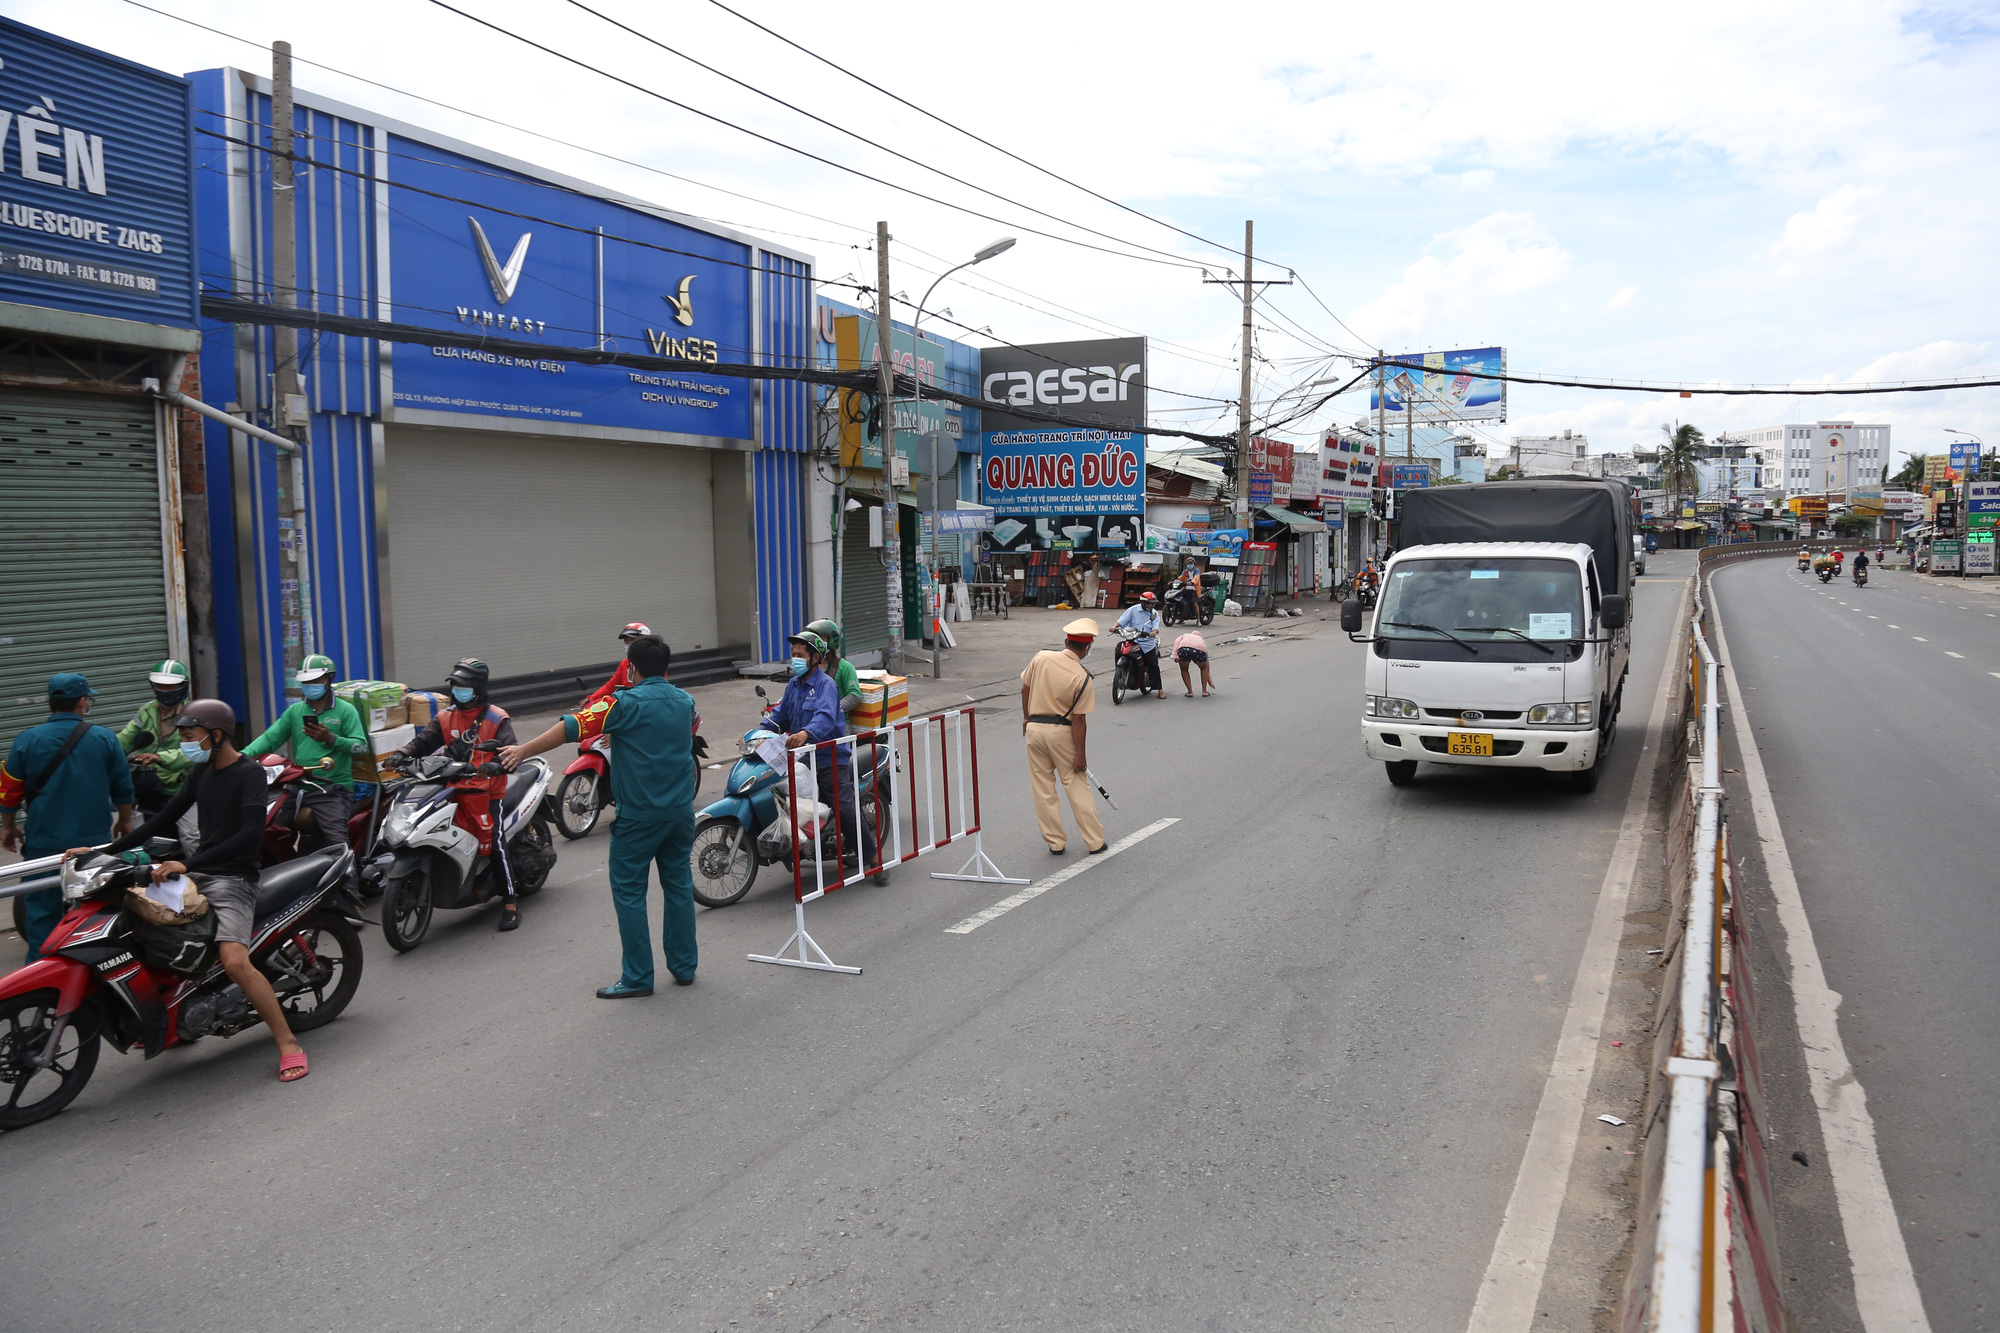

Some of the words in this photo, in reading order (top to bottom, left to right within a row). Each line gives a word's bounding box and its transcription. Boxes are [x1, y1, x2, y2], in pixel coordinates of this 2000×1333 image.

[0, 201, 110, 244] LUESCOPE
[117, 226, 163, 254] ZACS
[18, 254, 43, 272] 3726
[77, 264, 98, 281] FAX:
[99, 268, 112, 284] 08
[113, 271, 135, 288] 3726
[136, 276, 157, 291] 1659
[456, 306, 546, 336] VINFAST
[540, 361, 566, 374] ĐIỆN
[628, 373, 660, 386] TRUNG
[660, 376, 679, 388] TÂM
[699, 384, 730, 396] NGHIỆM
[642, 392, 664, 403] DỊCH
[665, 395, 676, 406] VỤ
[677, 396, 718, 409] VINGROUP
[991, 431, 1010, 445] CỬA
[1011, 431, 1036, 444] HÀNG
[1038, 433, 1069, 444] TRANG
[1071, 429, 1086, 442] TRÍ
[1088, 430, 1105, 443] NỘI
[1962, 444, 1978, 454] NHÀ
[986, 453, 1075, 493] QUANG
[1081, 443, 1138, 488] ĐỨC
[1016, 494, 1031, 503] THIẾT
[1032, 496, 1038, 504] BỊ
[1084, 494, 1099, 503] GẠCH
[1112, 493, 1123, 501] CÁC
[1124, 494, 1137, 503] LOẠI
[1972, 486, 1984, 495] NHÀ
[324, 716, 341, 725] Grab
[1460, 734, 1480, 744] 51C
[1452, 744, 1487, 755] 635.81
[97, 951, 134, 971] YAMAHA
